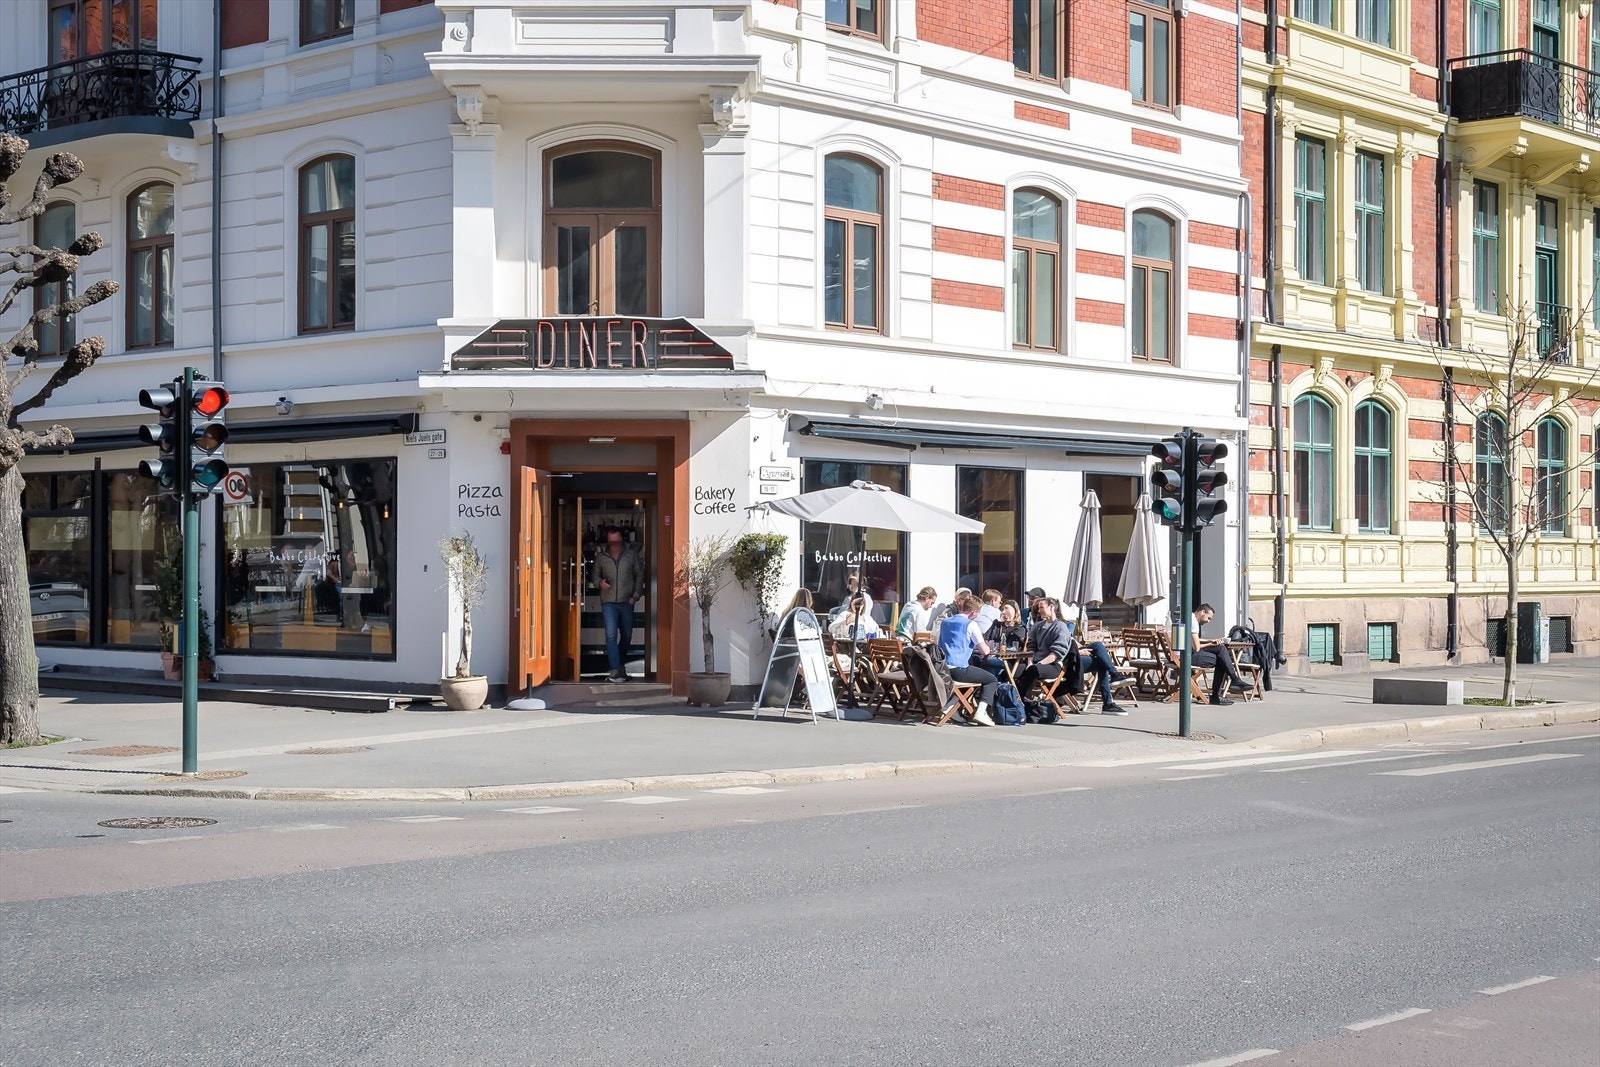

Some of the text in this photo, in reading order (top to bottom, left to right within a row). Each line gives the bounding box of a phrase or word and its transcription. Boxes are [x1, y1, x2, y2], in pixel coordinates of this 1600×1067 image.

[538, 320, 649, 368] DINER
[406, 432, 442, 444] Niels Juels gate
[458, 484, 504, 499] Pizza
[695, 486, 735, 501] Bakery
[458, 504, 502, 517] Pasta
[694, 502, 736, 515] Coffee
[269, 550, 294, 563] Babbo
[815, 550, 891, 564] Babbo Collective
